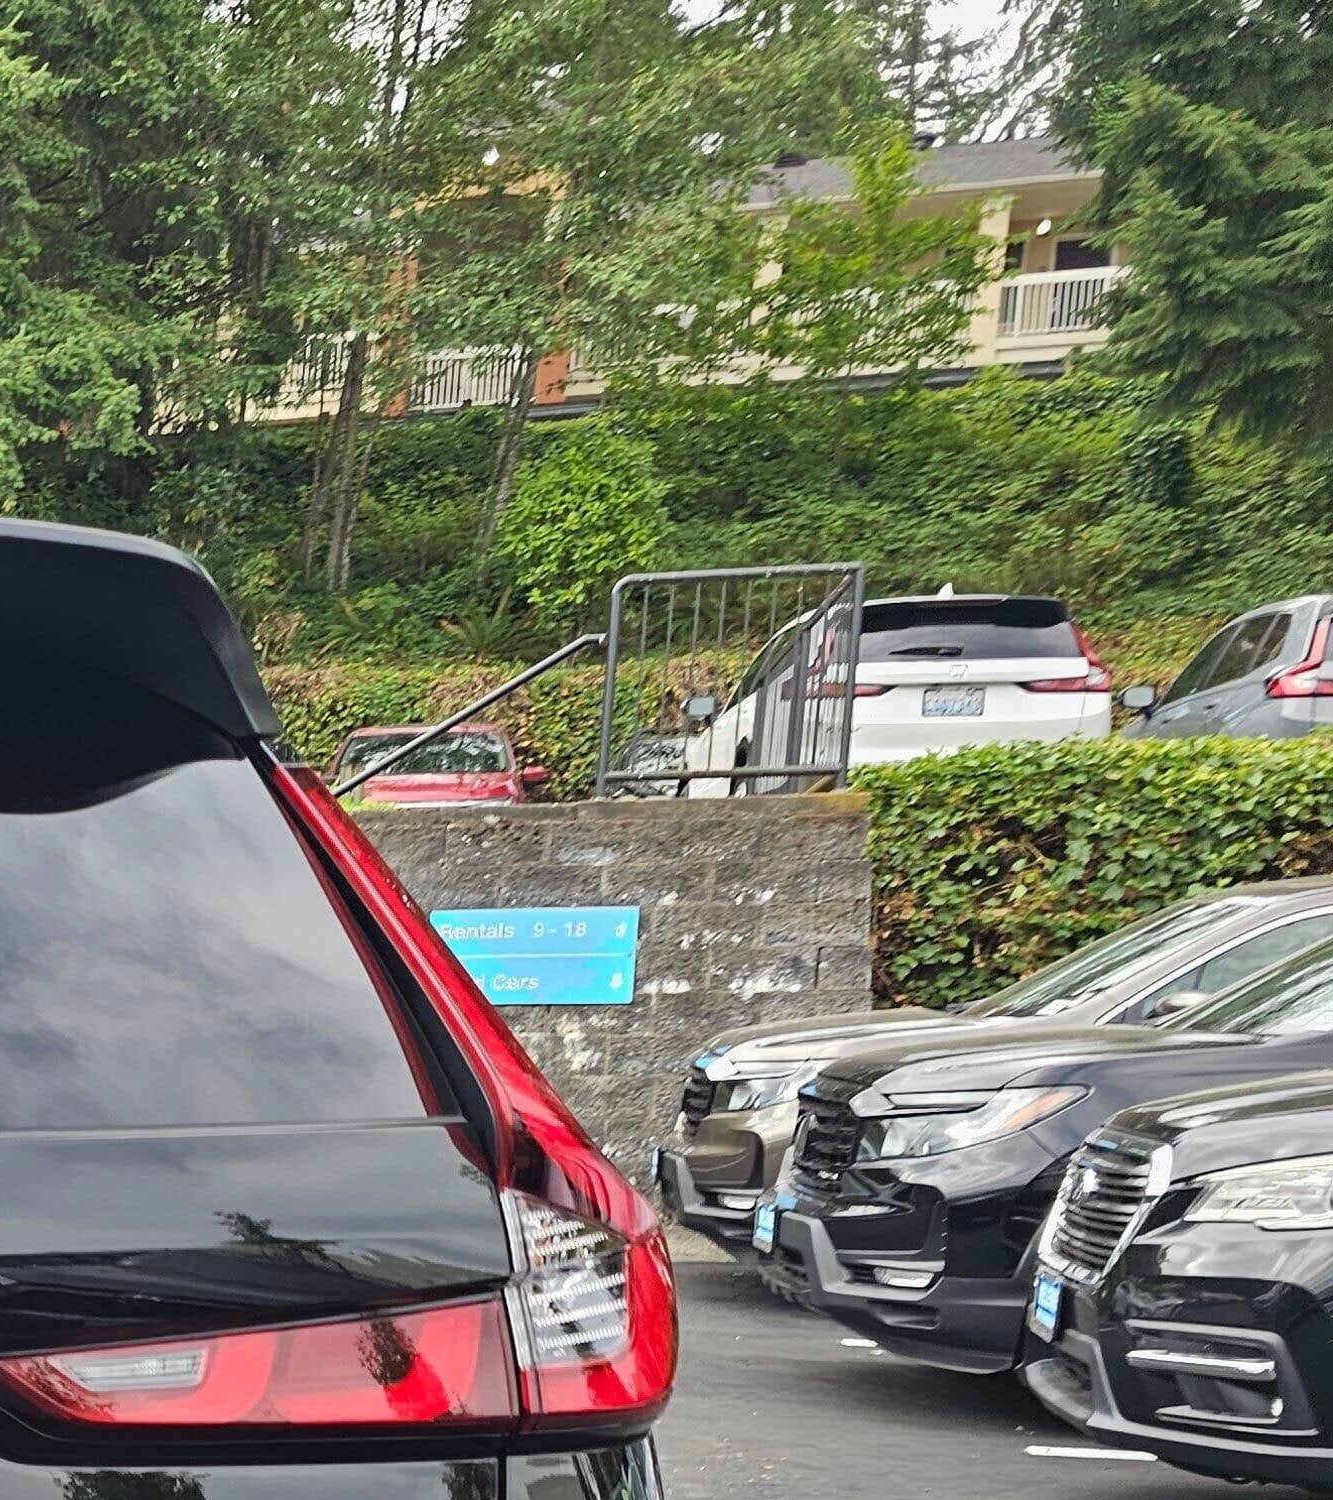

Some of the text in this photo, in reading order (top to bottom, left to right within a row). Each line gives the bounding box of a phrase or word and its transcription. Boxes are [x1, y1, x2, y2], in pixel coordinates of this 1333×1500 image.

[532, 923, 546, 938] 9
[565, 922, 587, 937] 18
[492, 974, 540, 990] Cars
